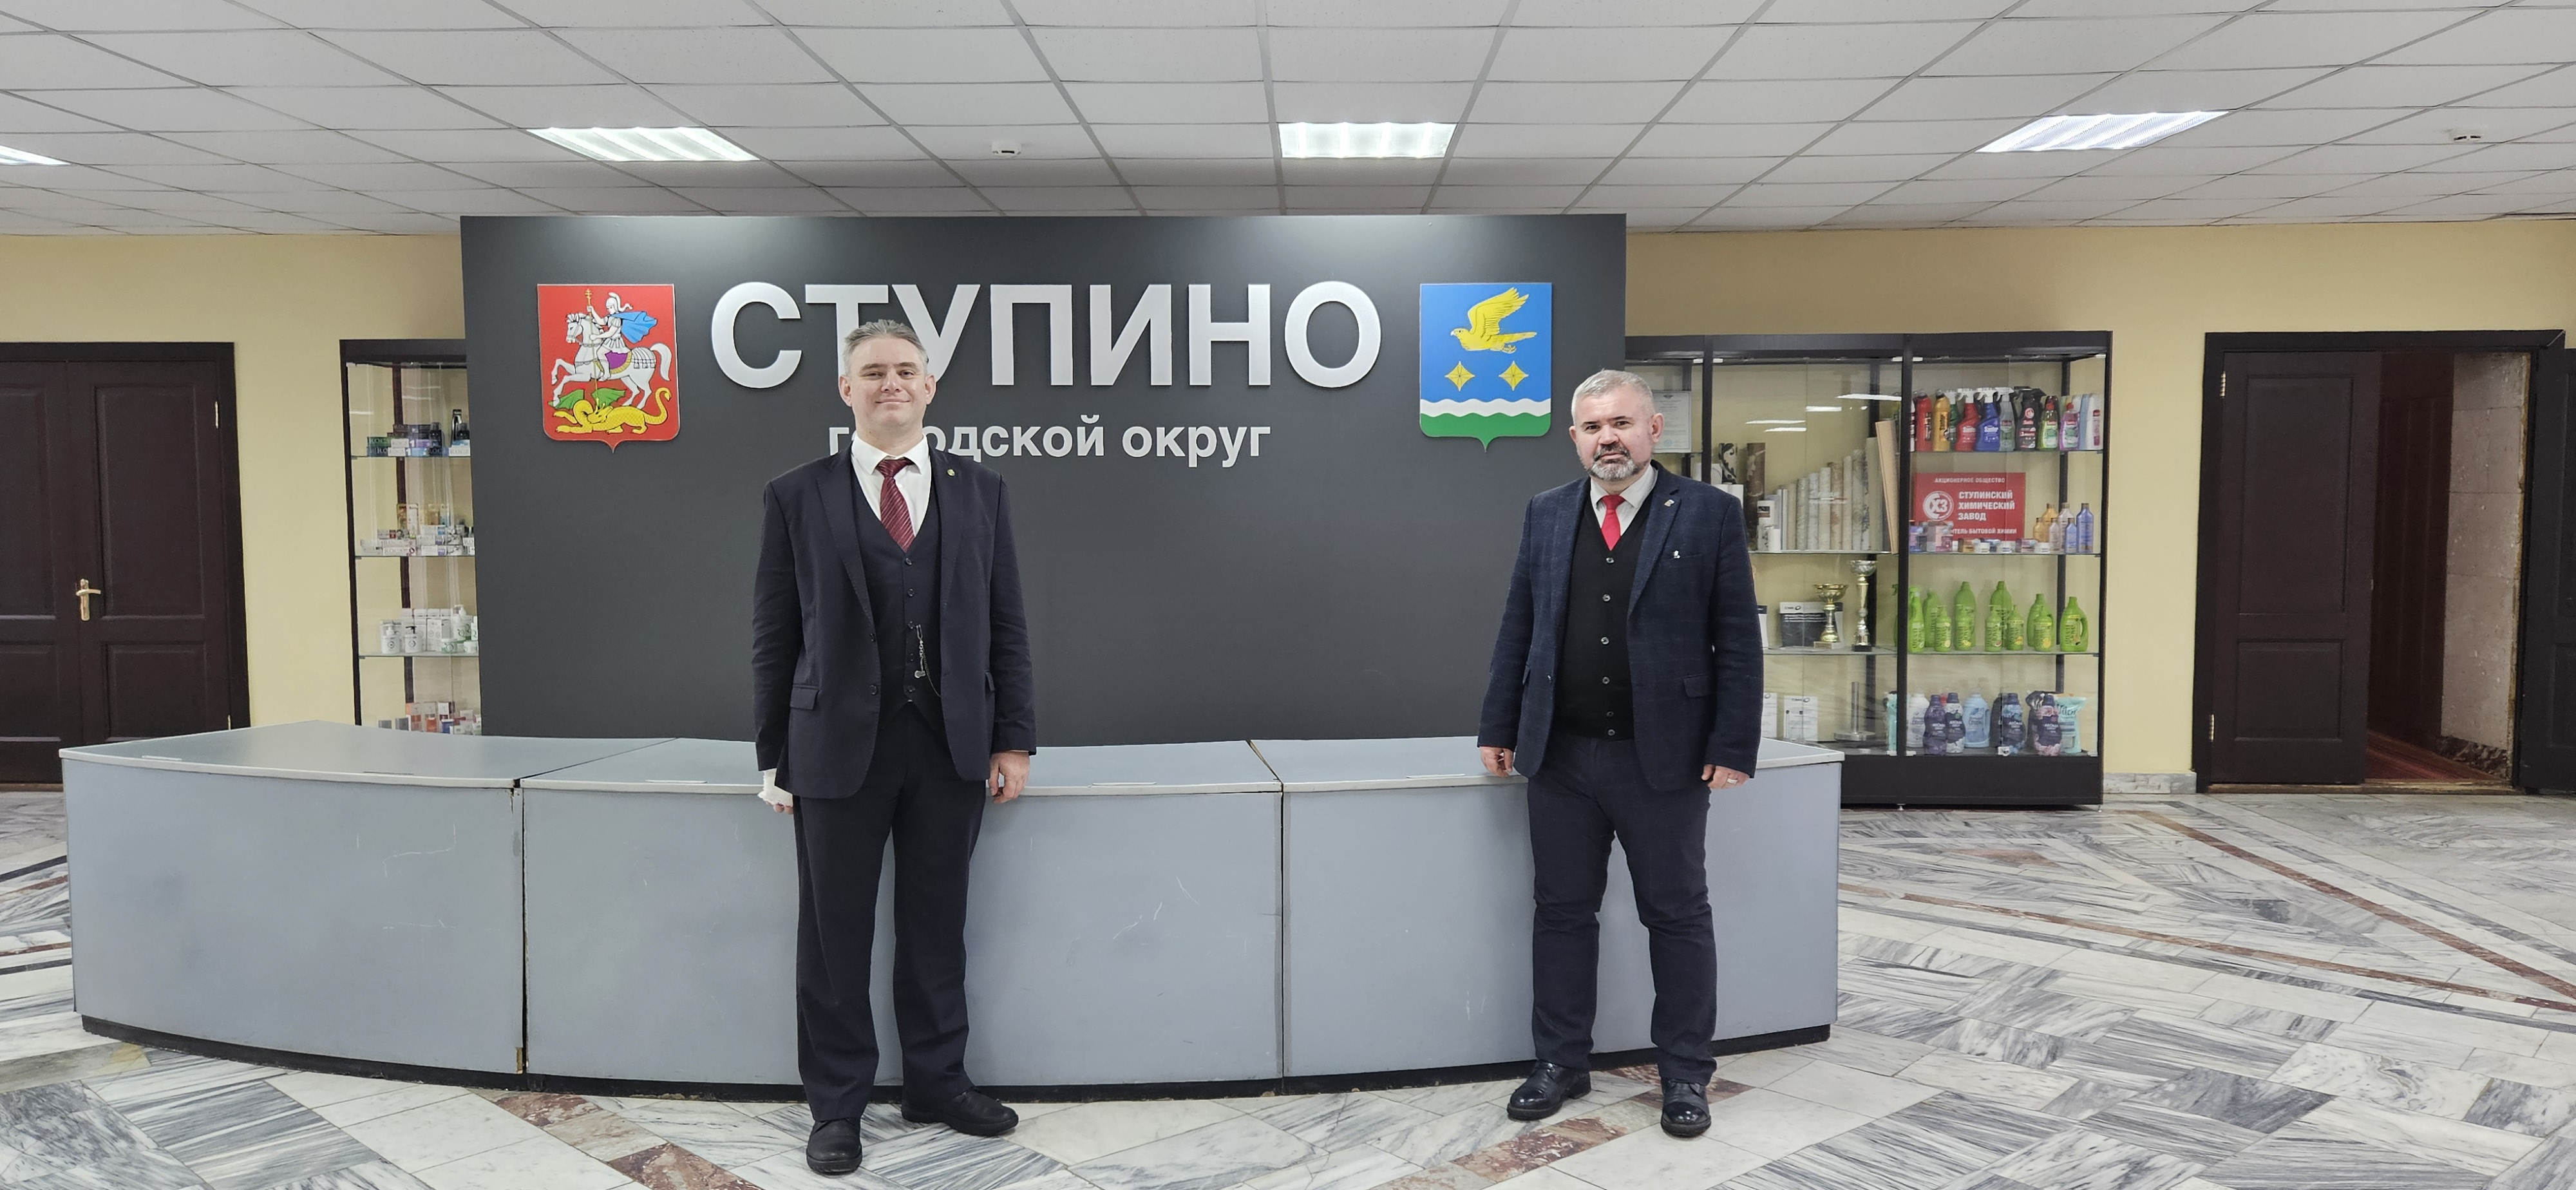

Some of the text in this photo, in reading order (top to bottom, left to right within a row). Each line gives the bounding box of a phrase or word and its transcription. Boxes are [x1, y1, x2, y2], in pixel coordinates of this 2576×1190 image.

[710, 281, 1382, 388] СТУПИНО
[1121, 426, 1271, 468] округ
[1958, 489, 2013, 500] СТУПИНСКИЙ
[1958, 500, 2016, 510] ХИМИЧЕСКИЙ
[1958, 513, 1987, 522] ЗАВОД
